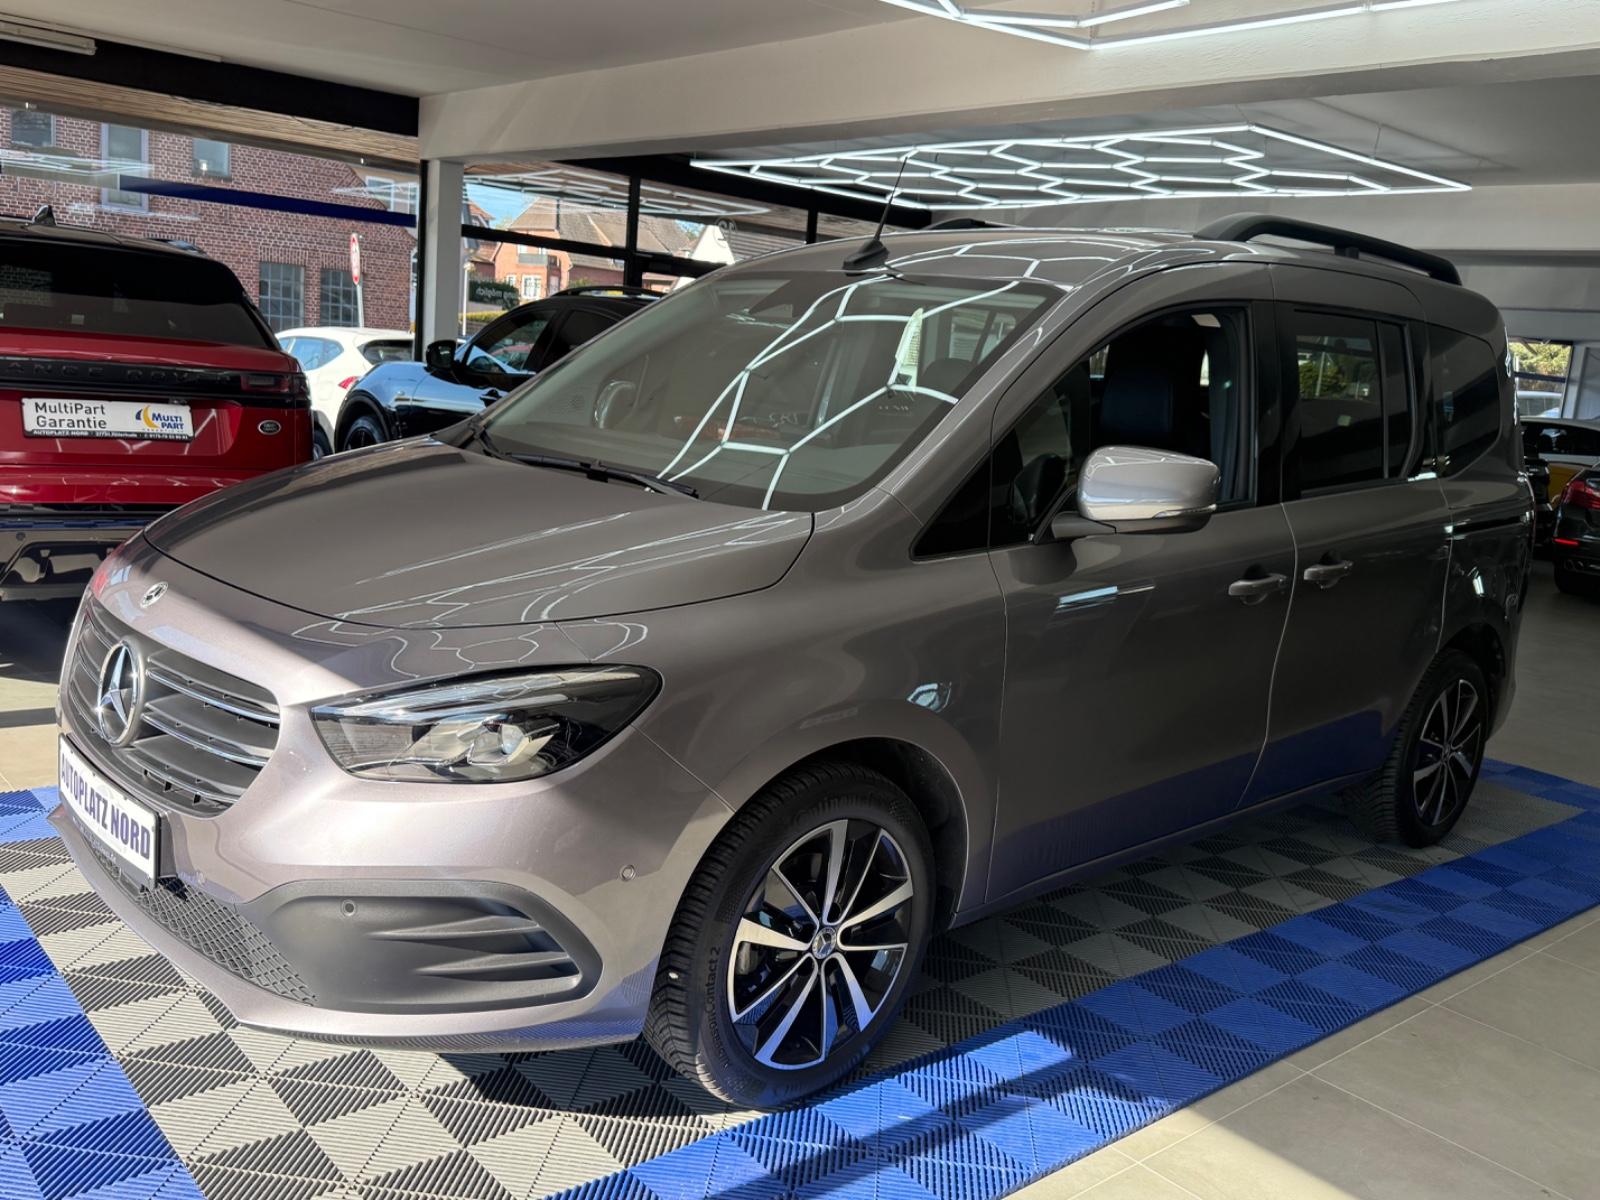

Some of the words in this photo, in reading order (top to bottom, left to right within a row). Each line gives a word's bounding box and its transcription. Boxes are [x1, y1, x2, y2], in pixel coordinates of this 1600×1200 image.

[127, 368, 231, 384] ROVR
[35, 402, 106, 415] MultiPart
[36, 415, 107, 429] Garantie
[152, 413, 183, 422] MULTI
[161, 422, 185, 430] PART
[61, 753, 108, 830] AUTOPLATZ
[110, 804, 150, 860] NORD
